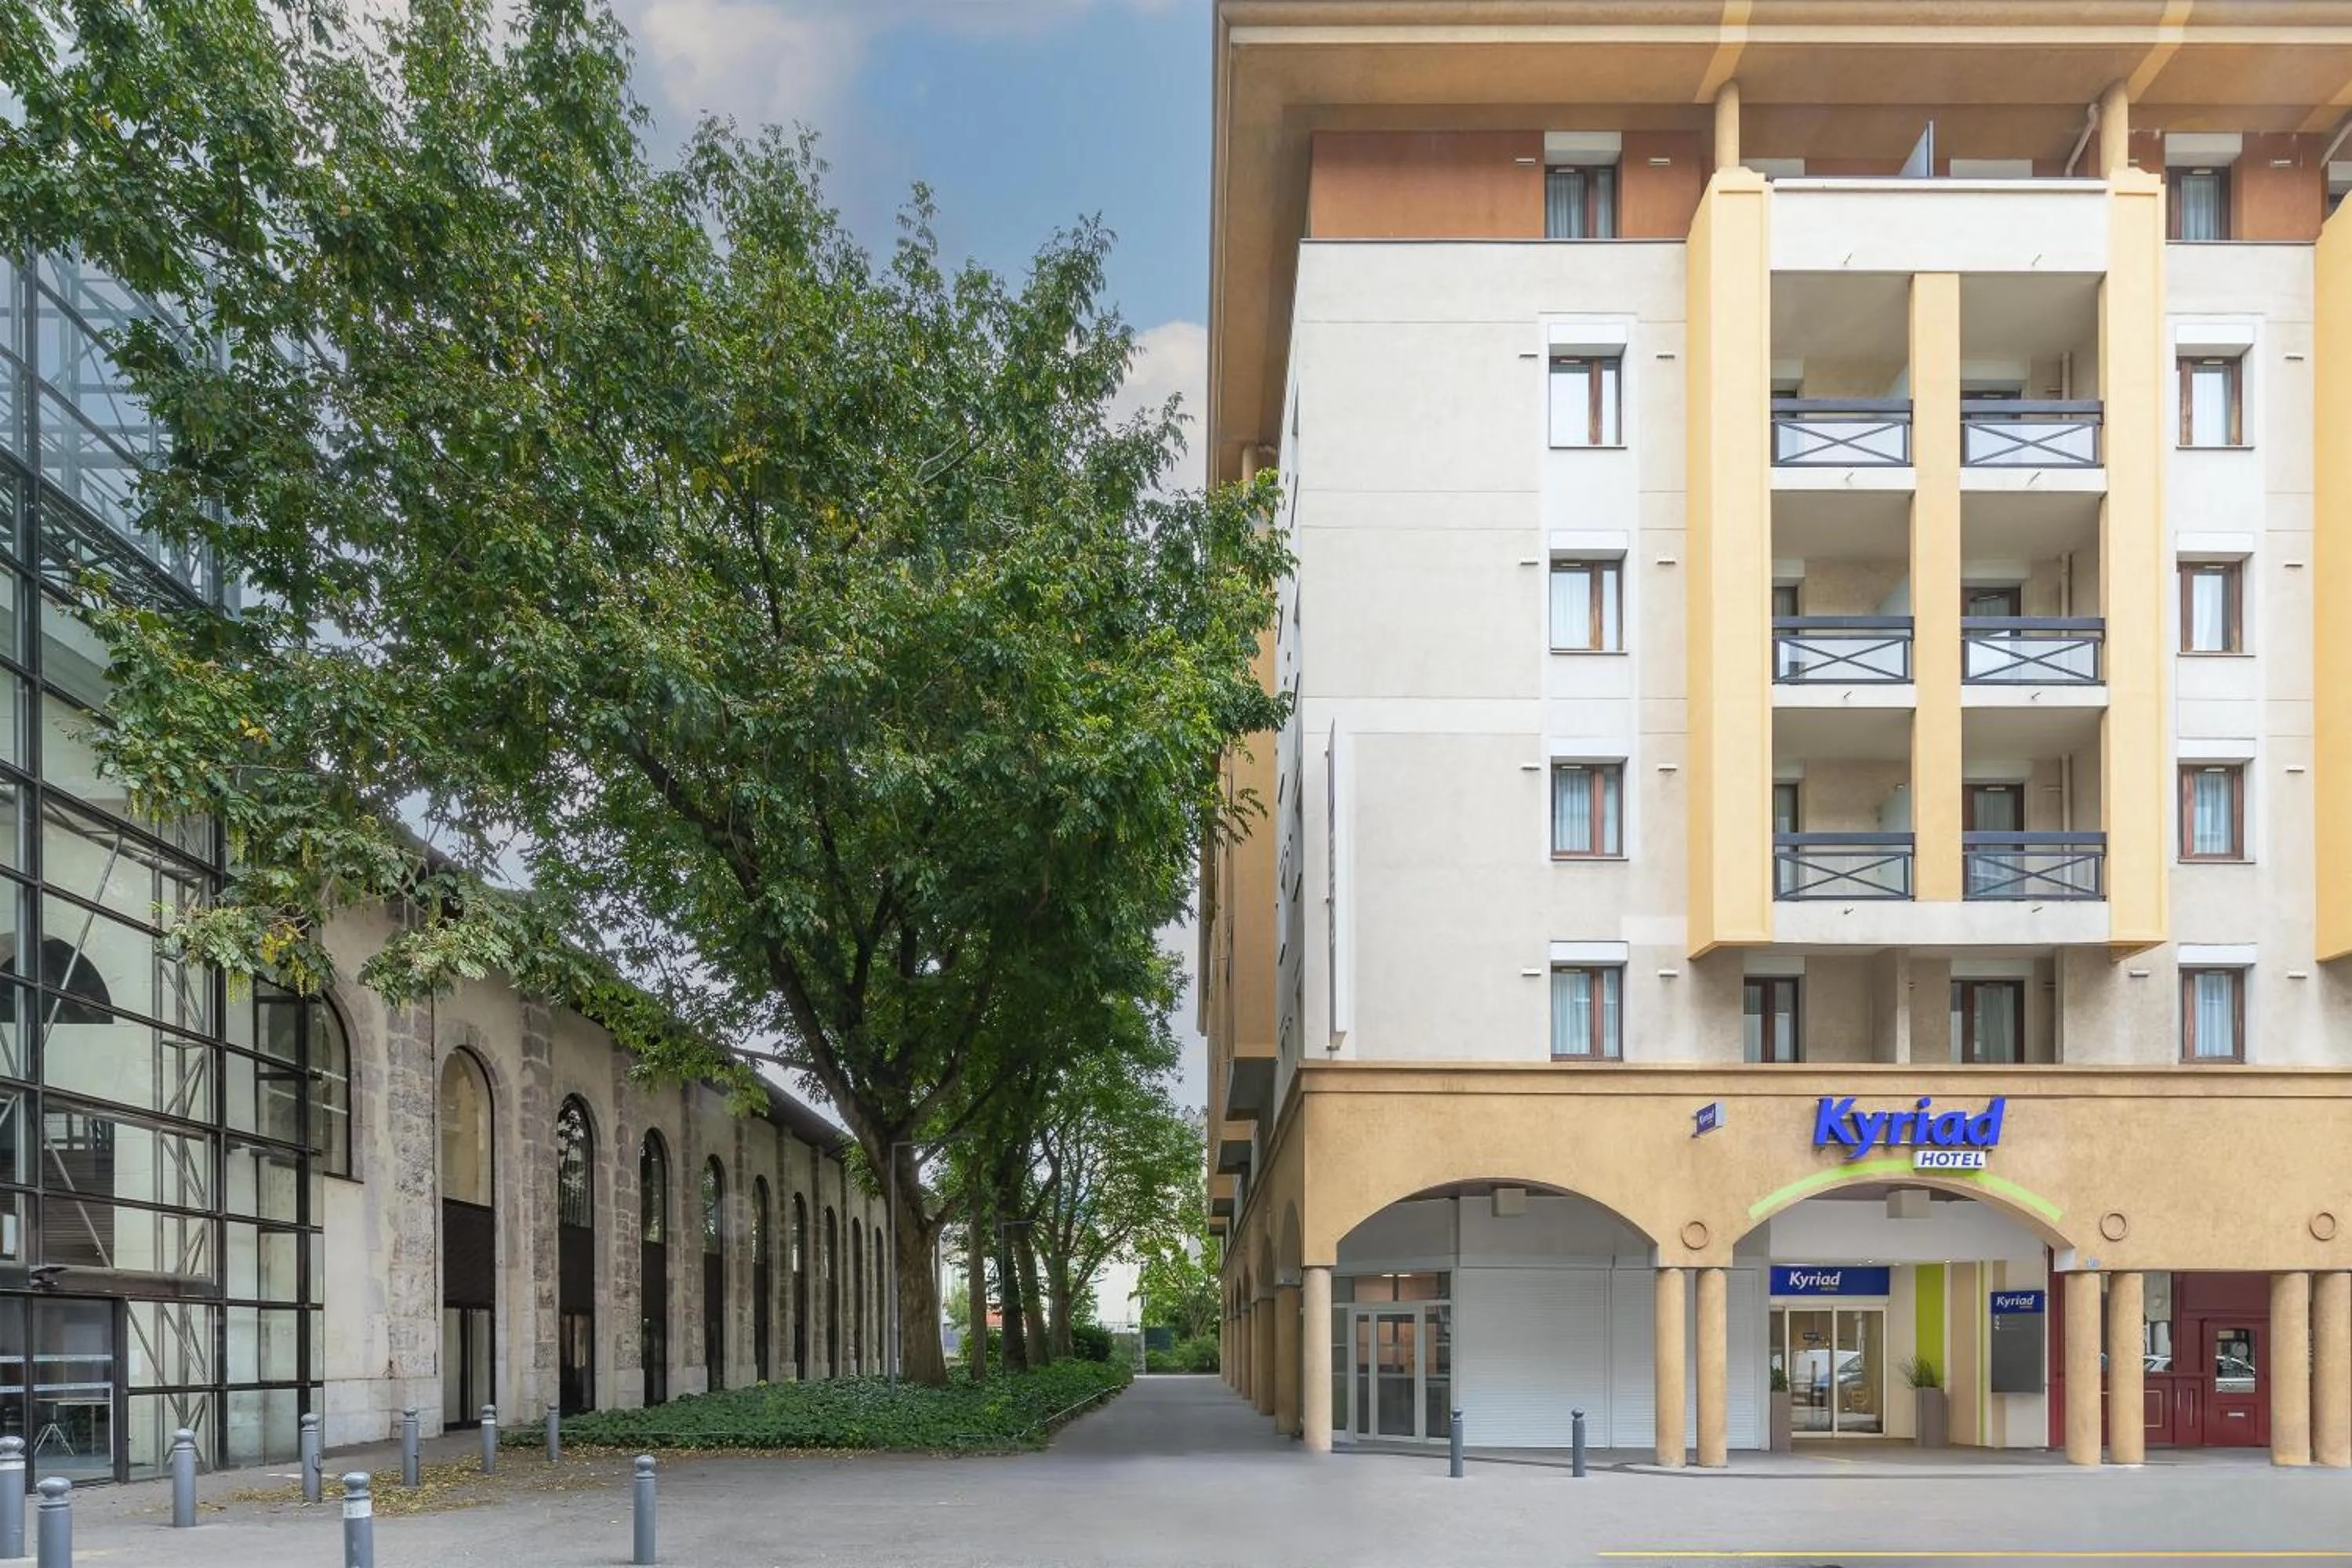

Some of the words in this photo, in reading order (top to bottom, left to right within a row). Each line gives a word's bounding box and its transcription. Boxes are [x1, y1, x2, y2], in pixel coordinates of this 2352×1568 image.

[1813, 1094, 2006, 1159] Kyriad
[1921, 1152, 1983, 1166] HOTEL
[1789, 1271, 1841, 1289] Kyriad
[1997, 1294, 2034, 1308] Kyriad
